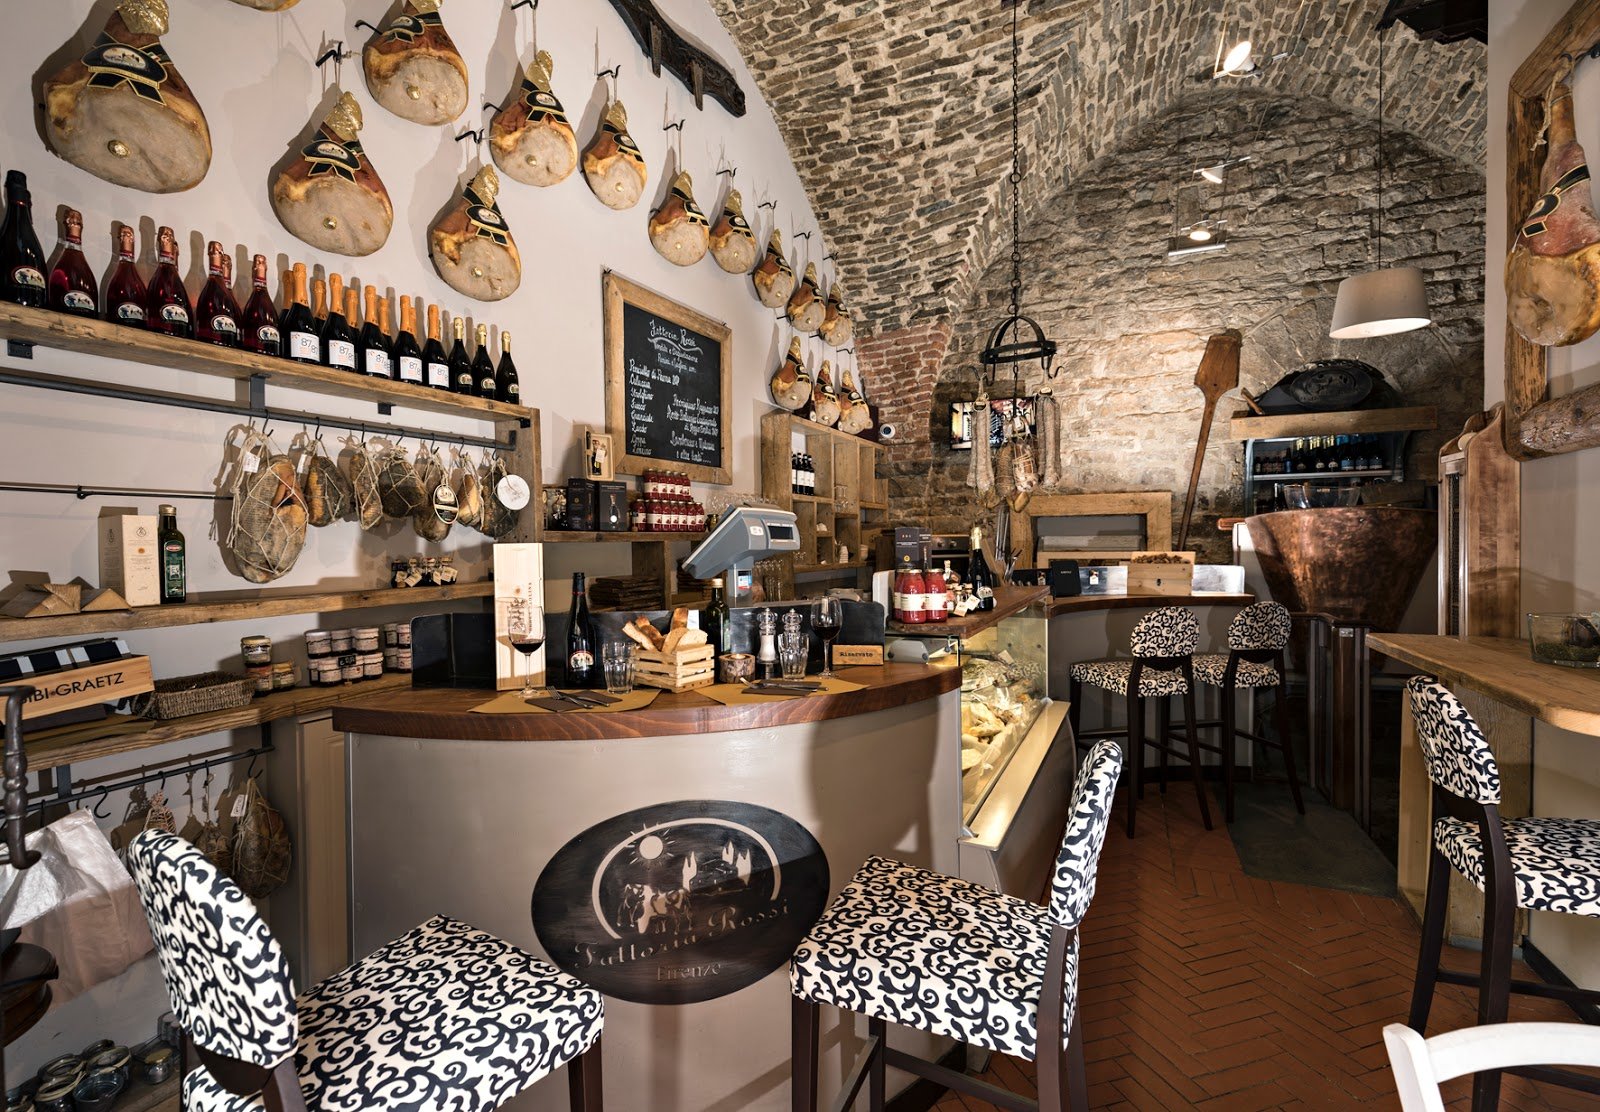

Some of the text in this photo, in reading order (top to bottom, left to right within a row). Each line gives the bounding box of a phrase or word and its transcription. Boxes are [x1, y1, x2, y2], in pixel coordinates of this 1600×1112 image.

[301, 337, 312, 348] 87
[340, 345, 349, 355] 87
[409, 361, 418, 370] 87
[55, 672, 125, 697] GRAETZ
[708, 898, 789, 937] Rossi
[657, 961, 722, 982] Firenze
